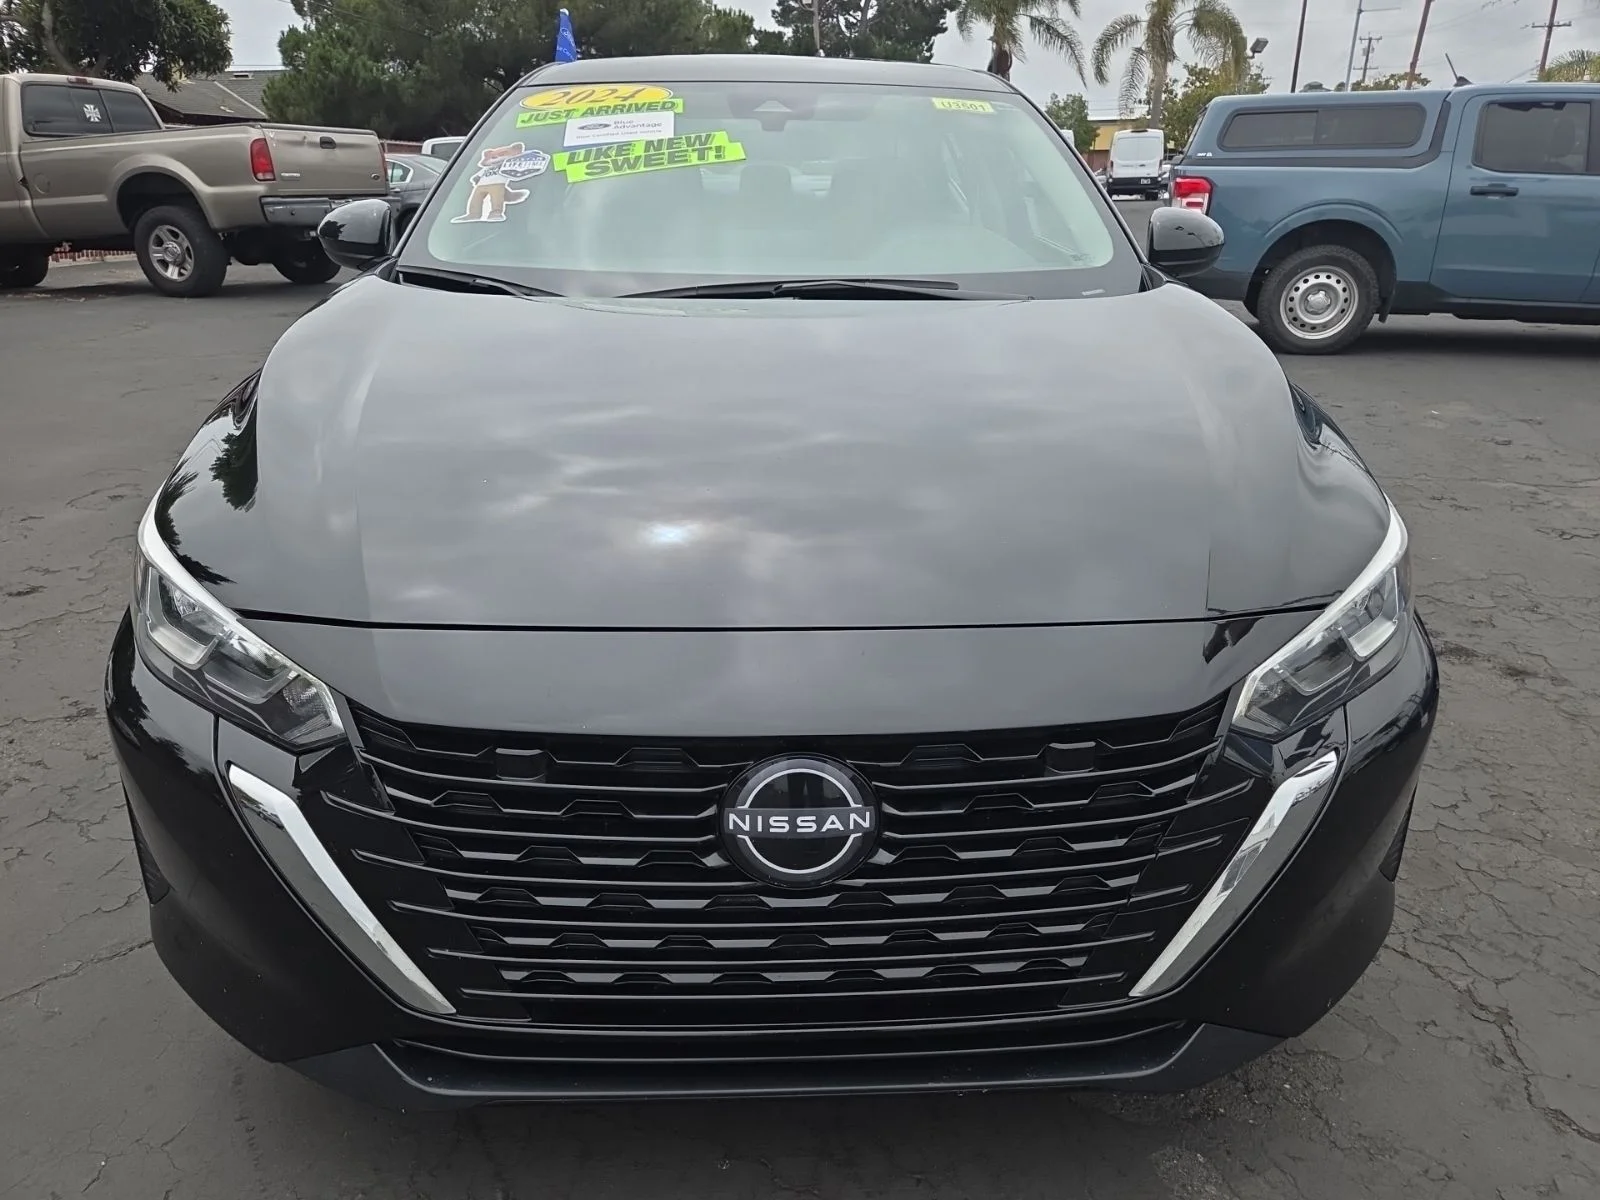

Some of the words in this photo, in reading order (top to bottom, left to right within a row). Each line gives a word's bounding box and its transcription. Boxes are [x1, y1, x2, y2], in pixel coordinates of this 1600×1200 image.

[537, 87, 647, 106] 2024
[521, 108, 577, 124] JUST
[580, 100, 677, 117] ARRIVED
[567, 143, 635, 165] LIKE
[644, 133, 716, 153] NEW
[584, 145, 726, 177] SWEET!
[728, 811, 870, 833] NISSAN
